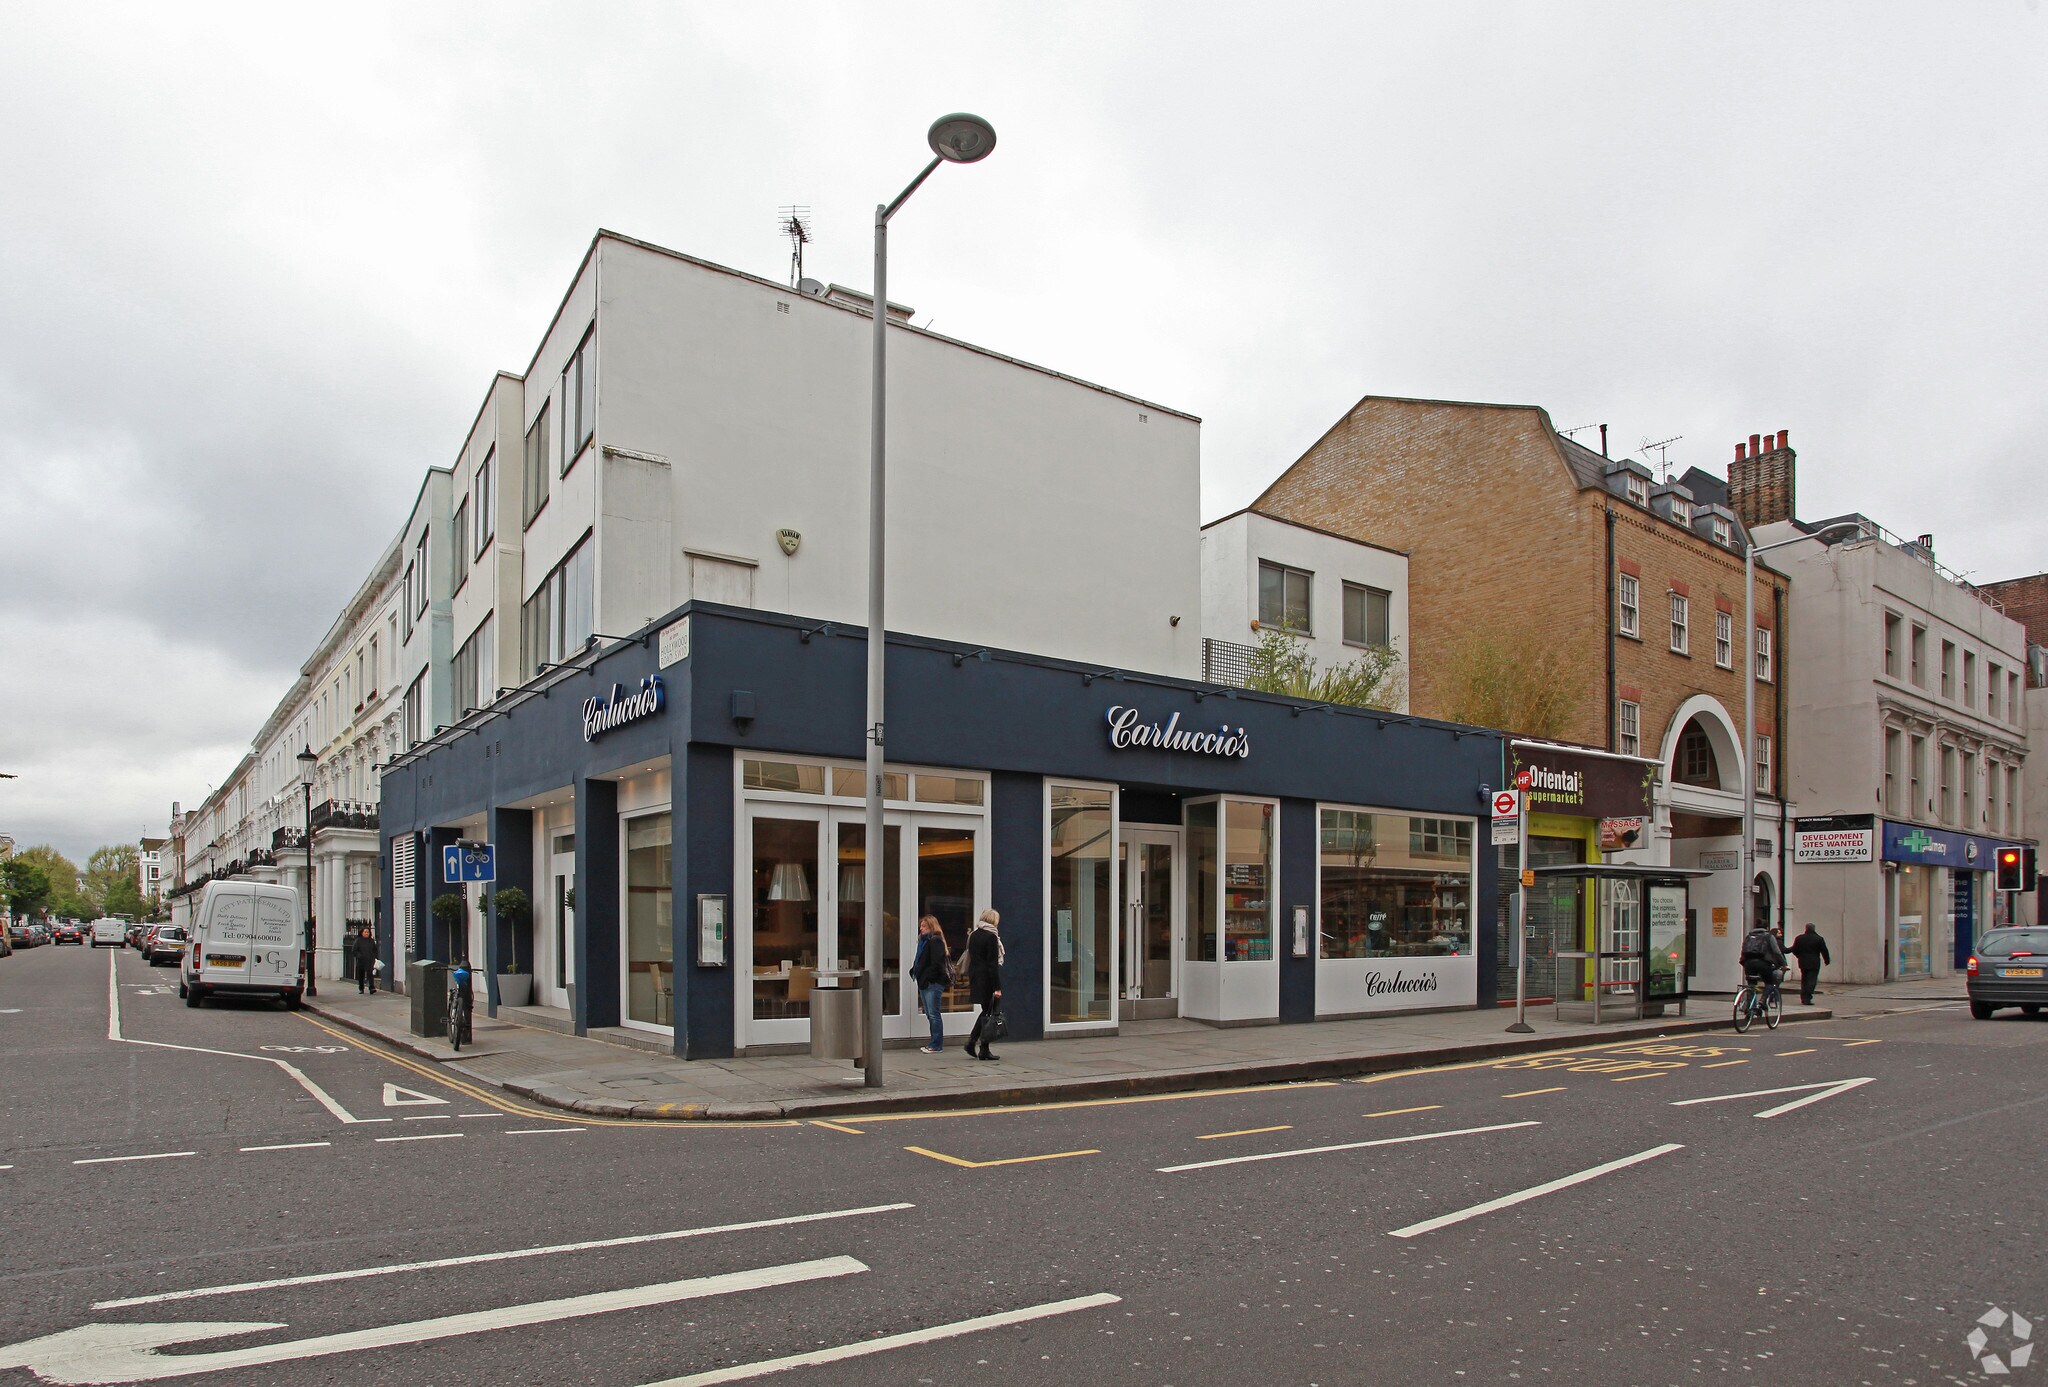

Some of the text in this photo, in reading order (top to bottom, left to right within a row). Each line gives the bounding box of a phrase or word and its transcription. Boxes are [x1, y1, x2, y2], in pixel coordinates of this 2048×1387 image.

[583, 674, 658, 742] Carluccio's
[1106, 705, 1250, 758] Carluccio's
[1517, 776, 1529, 785] HF
[1528, 791, 1578, 804] supermarket
[1601, 819, 1640, 829] MASSAGE
[1802, 832, 1864, 841] DEVELOPMENT
[1827, 840, 1864, 848] WANTED
[1844, 848, 1868, 856] 6740
[219, 902, 236, 913] CITY
[279, 907, 291, 919] LTD
[257, 934, 282, 942] 600016
[1365, 970, 1437, 997] Carluccio's
